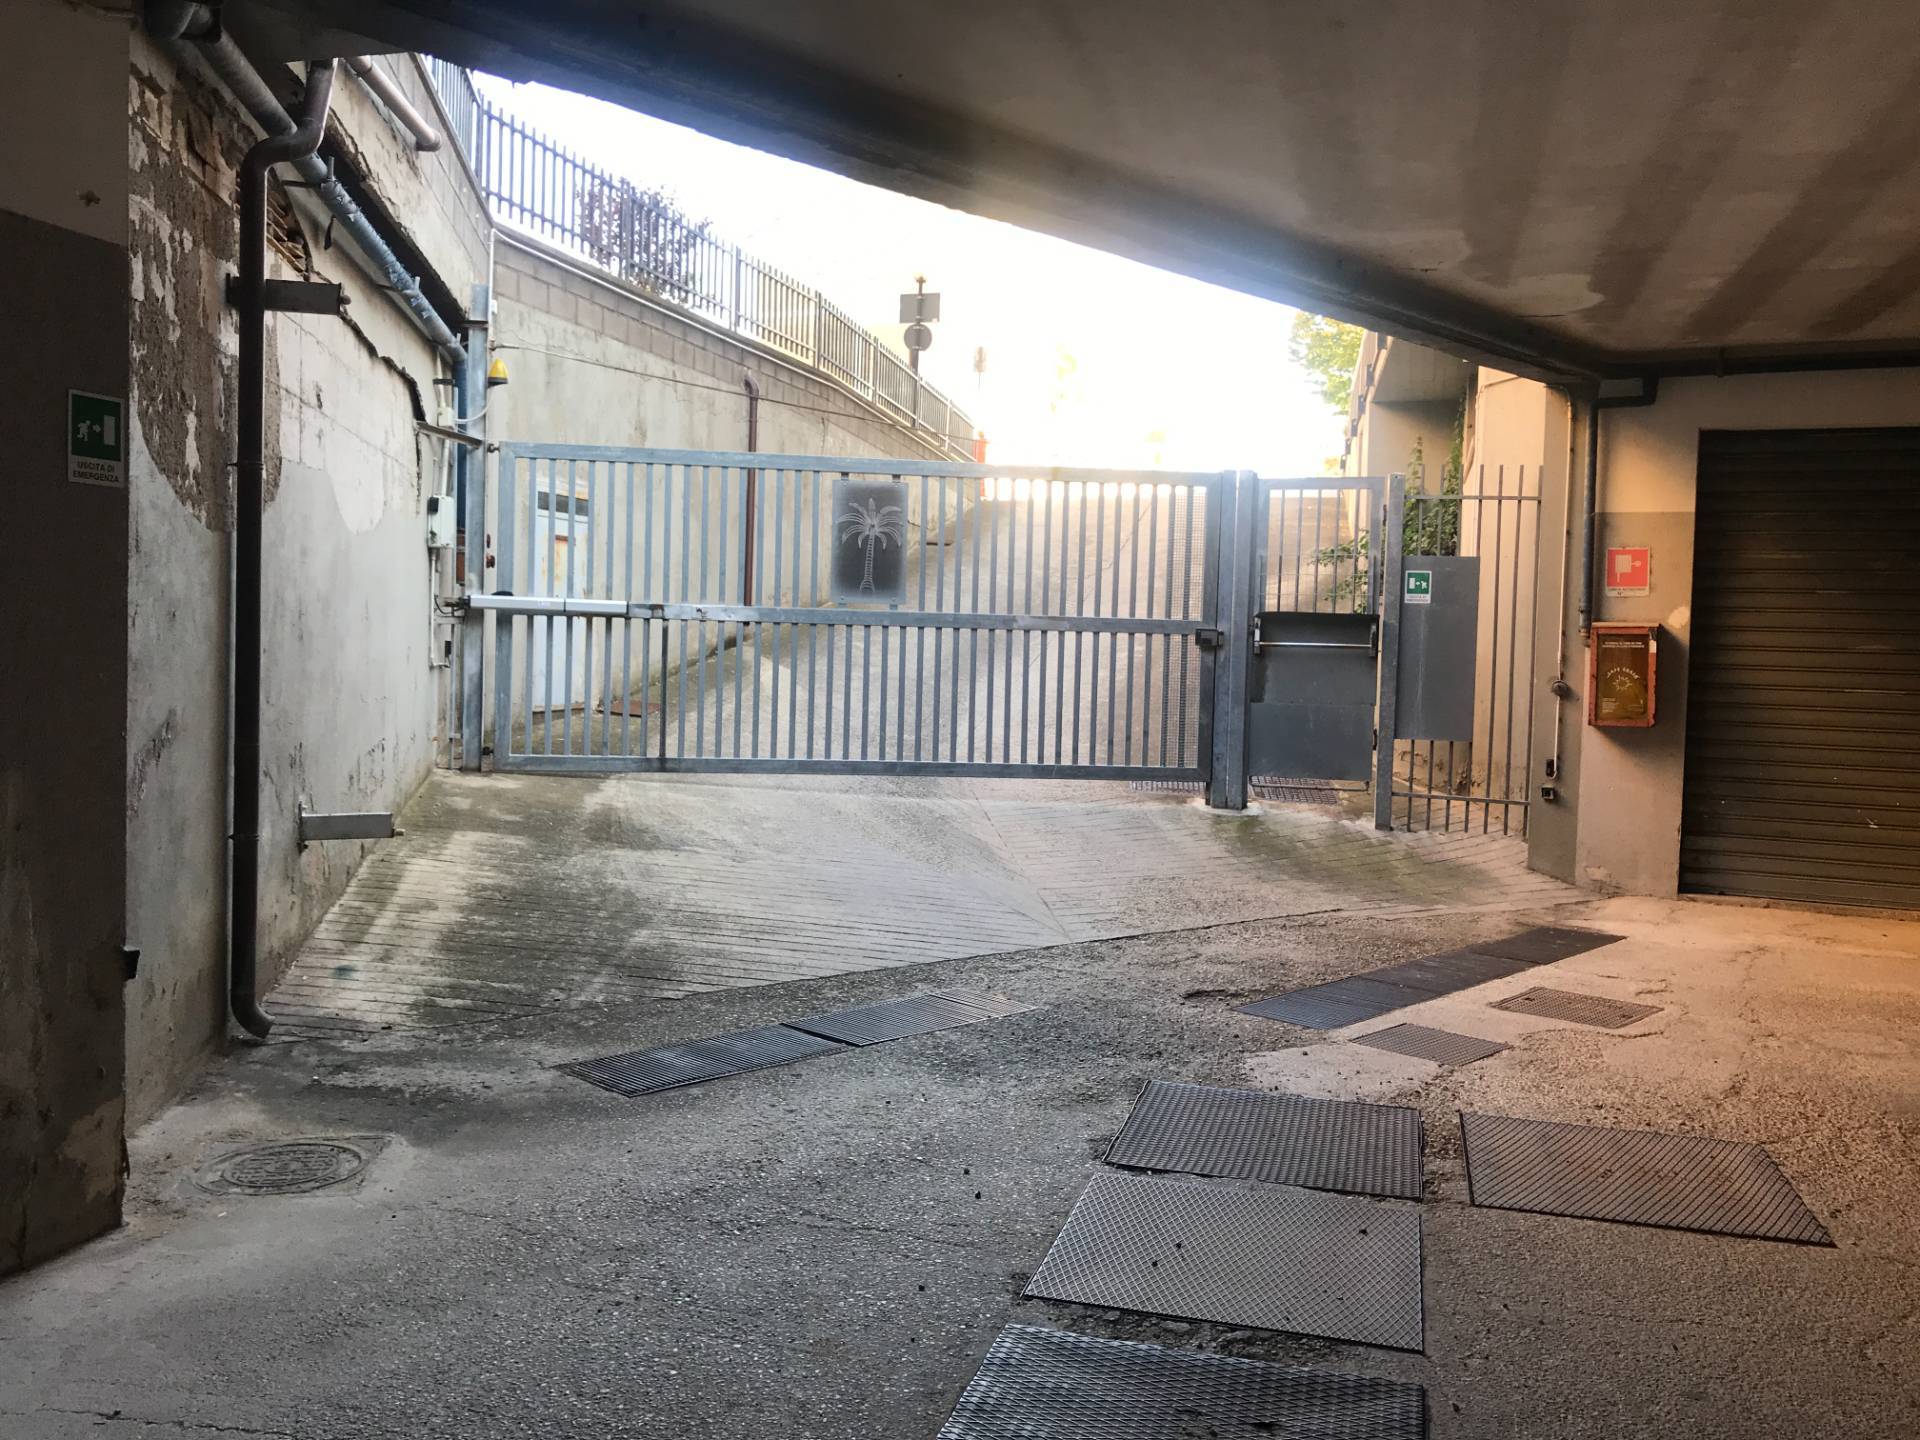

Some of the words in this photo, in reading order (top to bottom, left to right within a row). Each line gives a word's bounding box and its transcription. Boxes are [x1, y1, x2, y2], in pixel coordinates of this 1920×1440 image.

[77, 461, 106, 471] USCITA
[107, 464, 115, 473] DI
[73, 470, 119, 482] EMERGENZA
